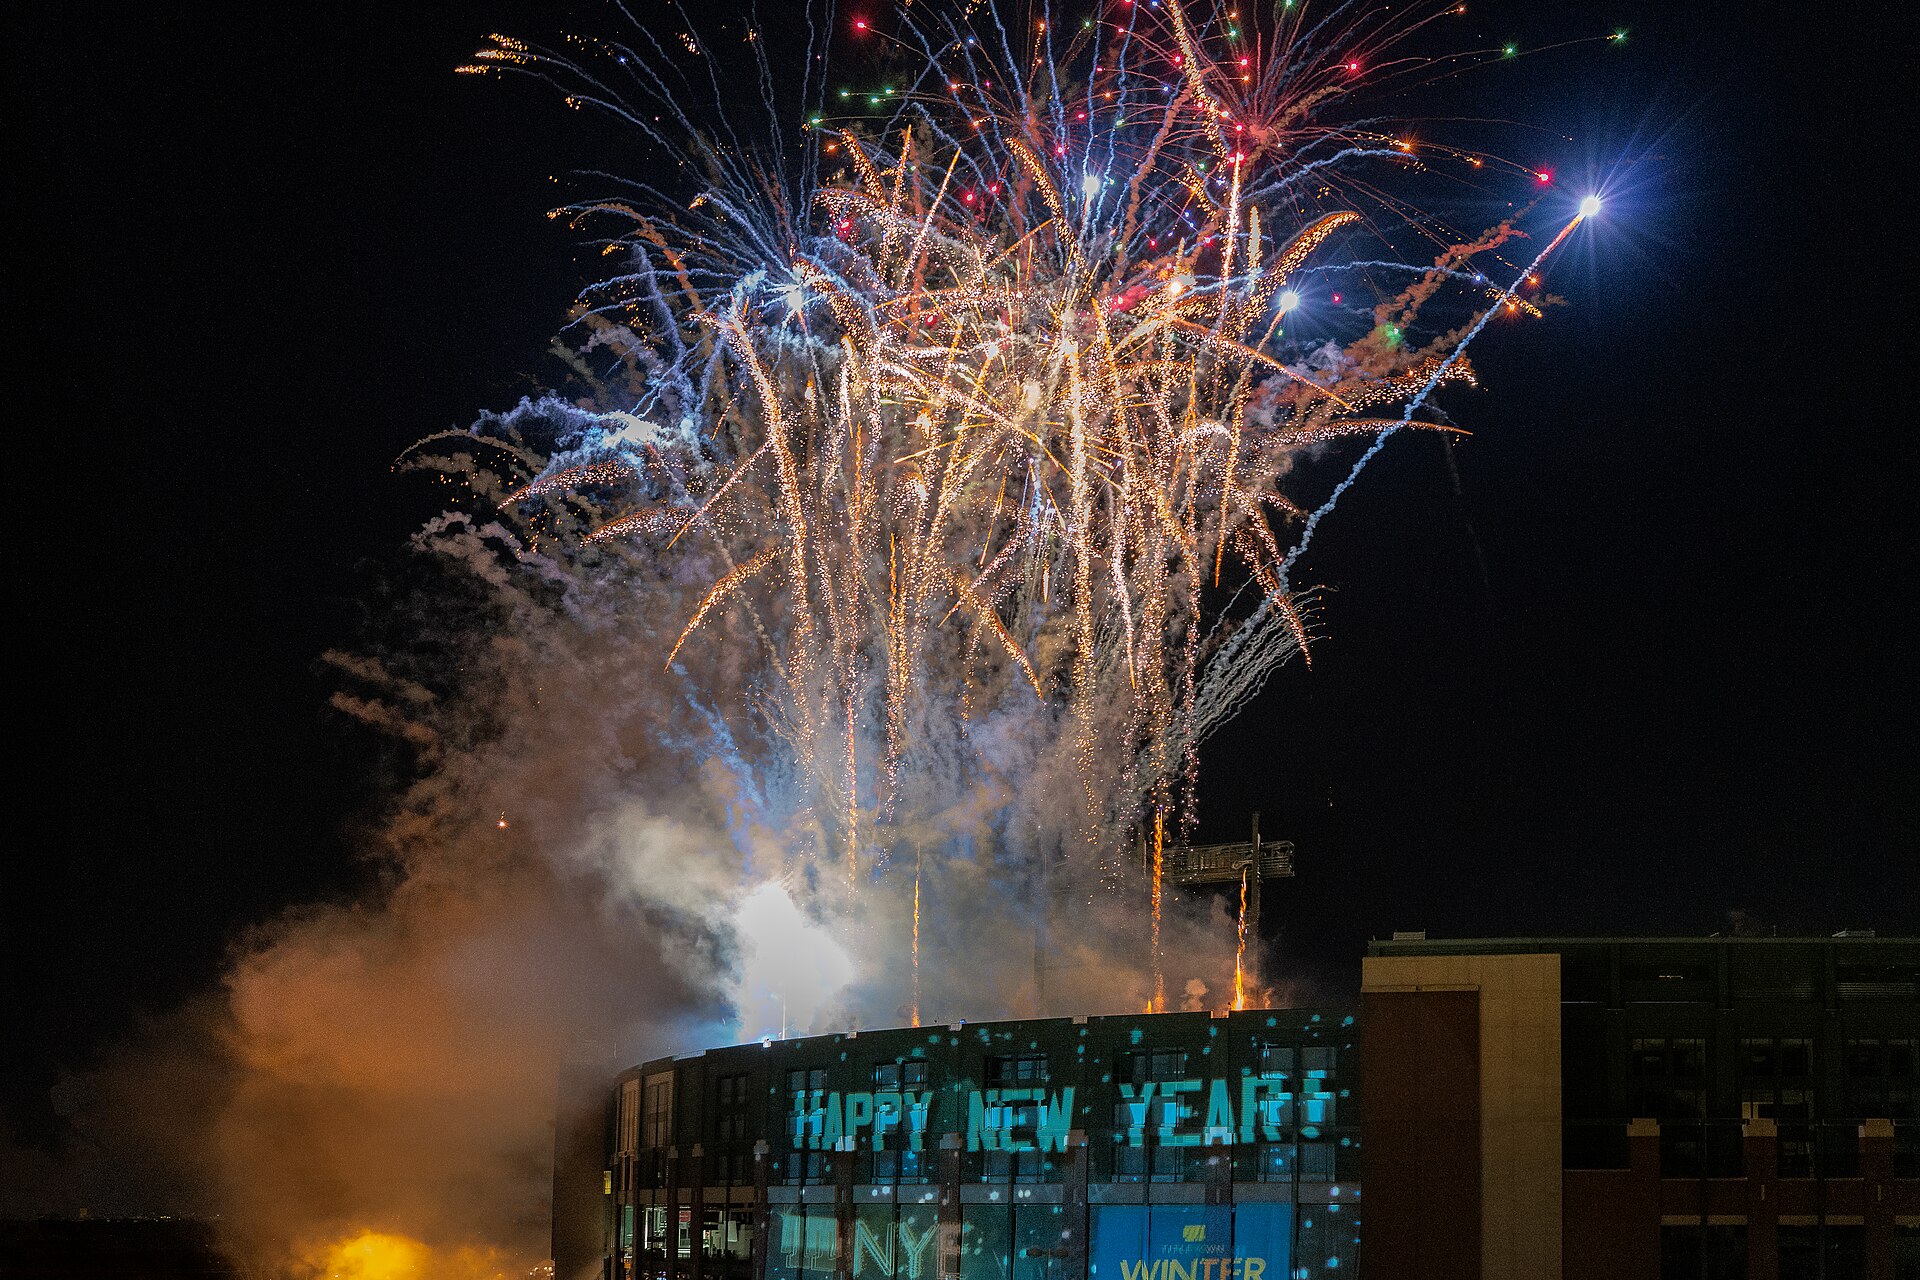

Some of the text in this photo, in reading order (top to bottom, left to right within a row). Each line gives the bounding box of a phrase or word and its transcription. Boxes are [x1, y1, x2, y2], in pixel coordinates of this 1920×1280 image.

[793, 1069, 1332, 1153] HAPPY NEW YEAR!
